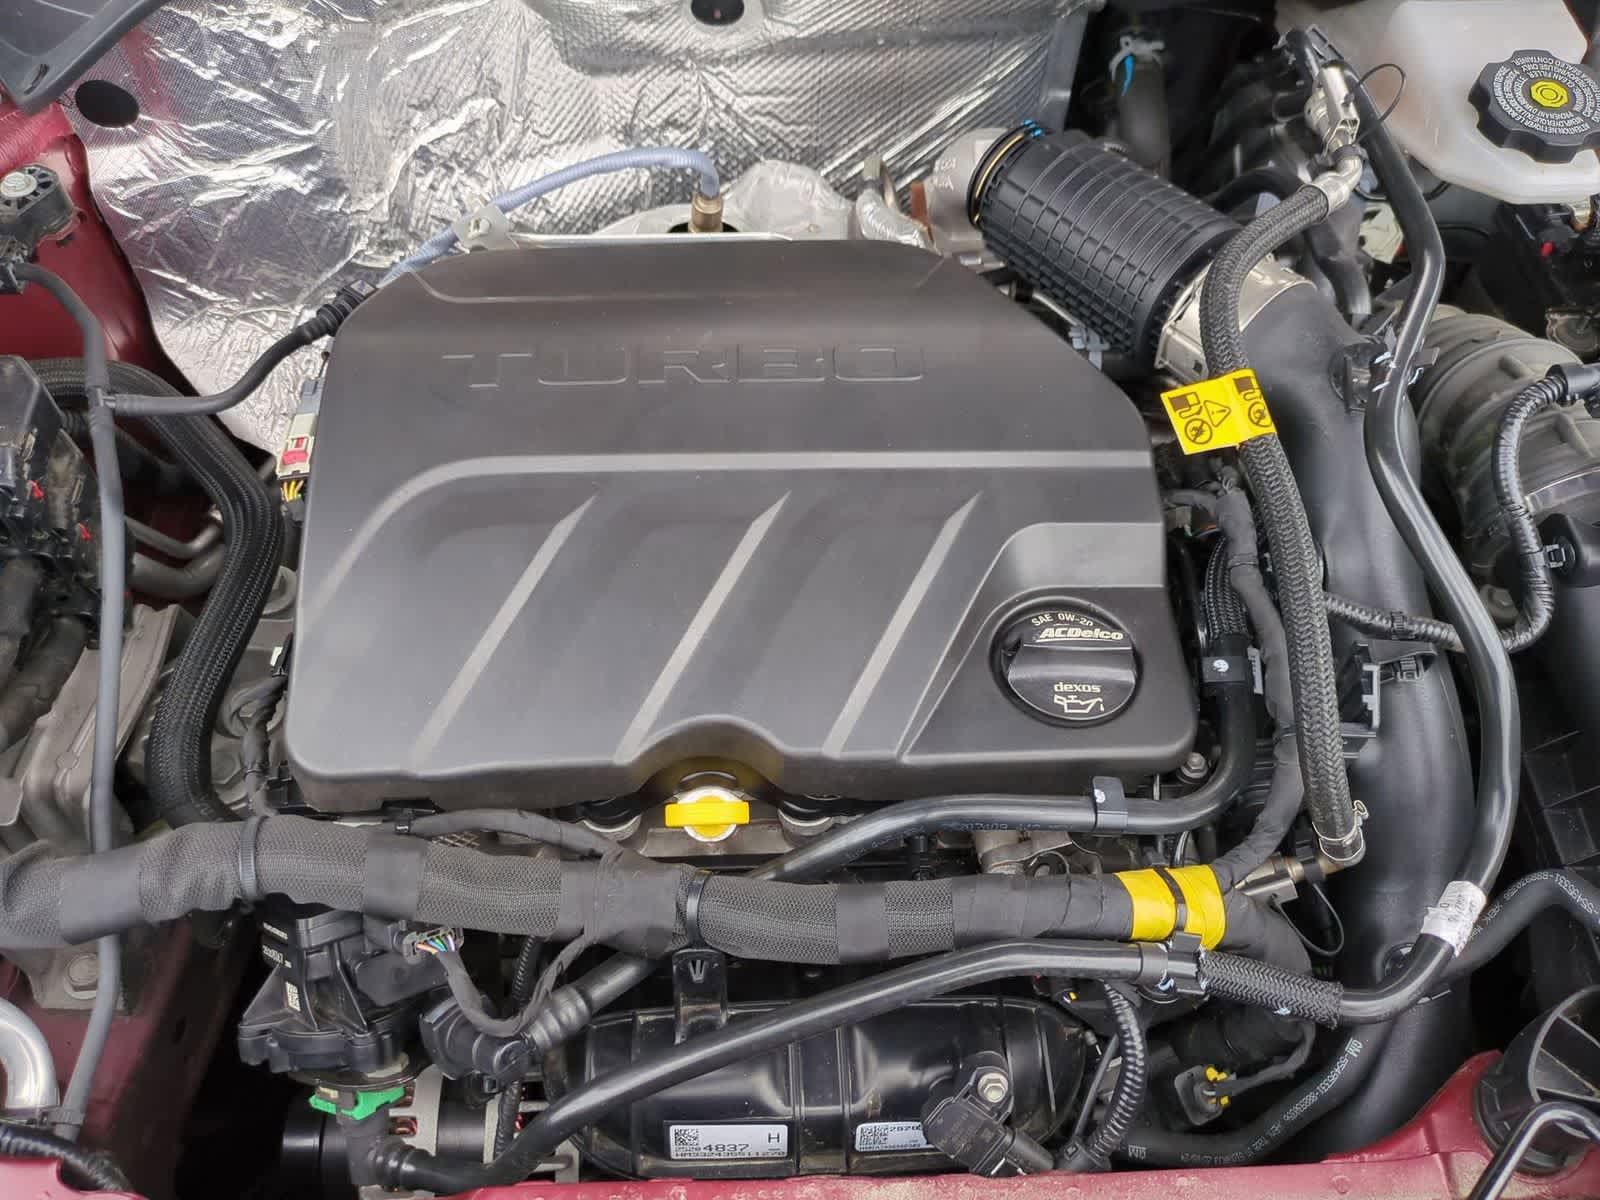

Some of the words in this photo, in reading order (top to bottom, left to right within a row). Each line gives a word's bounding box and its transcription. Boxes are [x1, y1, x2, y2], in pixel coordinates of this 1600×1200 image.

[442, 346, 923, 390] TURBO
[1031, 613, 1054, 626] SAE
[1039, 627, 1124, 640] ACDelco
[1053, 681, 1102, 693] dexos
[767, 1132, 780, 1143] H
